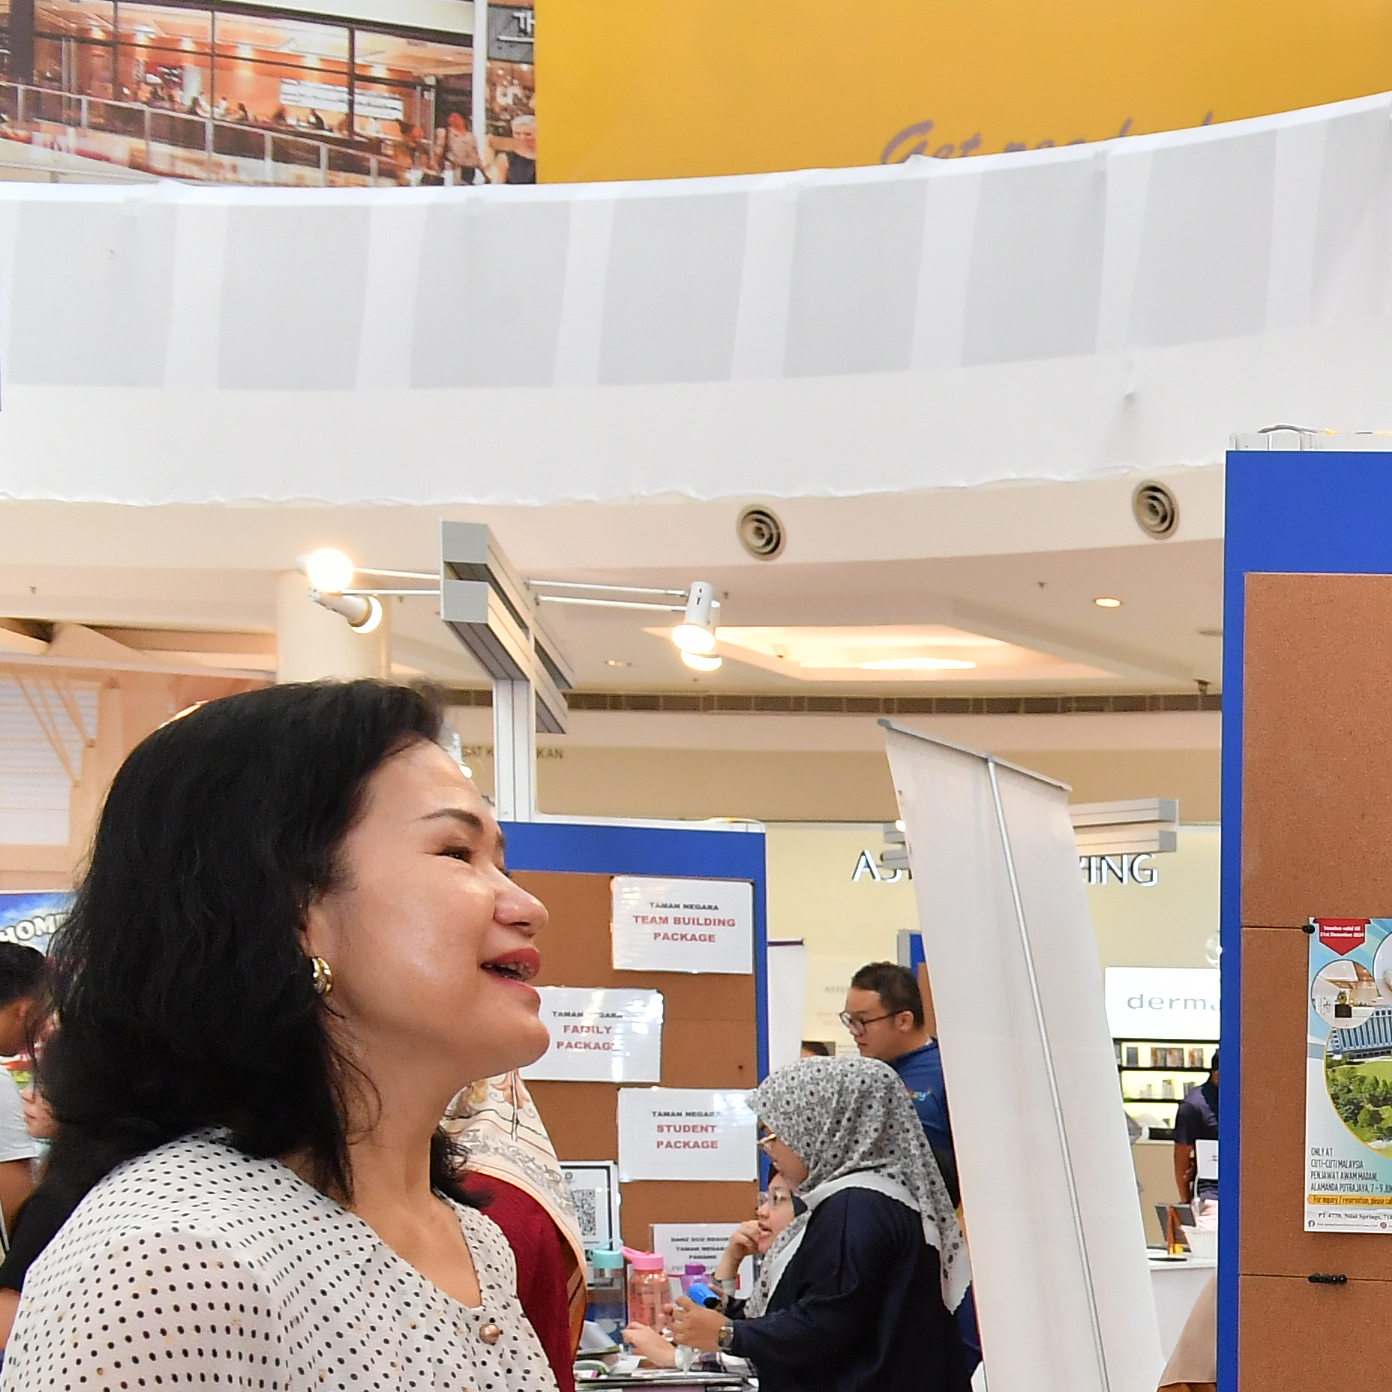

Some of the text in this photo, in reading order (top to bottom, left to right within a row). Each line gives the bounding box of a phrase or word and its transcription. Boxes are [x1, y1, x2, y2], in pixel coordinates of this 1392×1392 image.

[649, 901, 719, 911] TAMAN NEGARA
[632, 914, 736, 928] TEAM BUILDING
[653, 931, 716, 943] PACKAGE
[651, 1110, 683, 1118] TAMAN
[656, 1124, 717, 1133] STUDENT
[656, 1140, 718, 1150] PACKAGE
